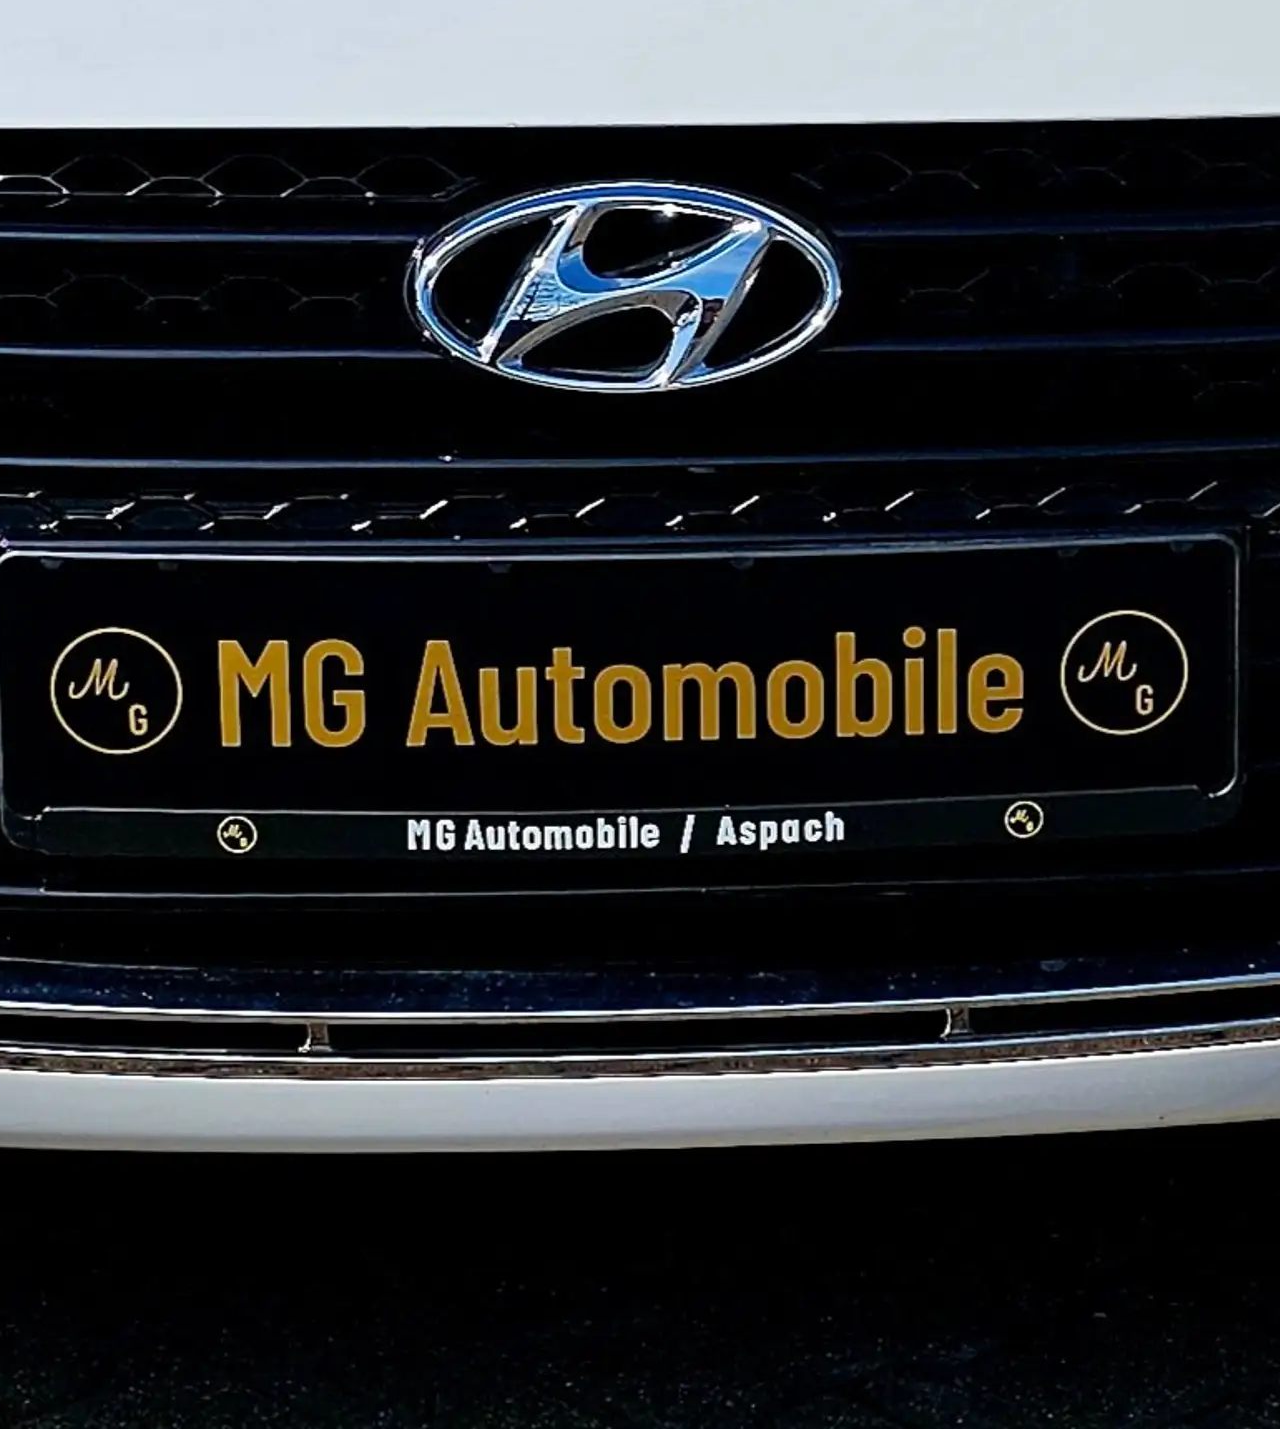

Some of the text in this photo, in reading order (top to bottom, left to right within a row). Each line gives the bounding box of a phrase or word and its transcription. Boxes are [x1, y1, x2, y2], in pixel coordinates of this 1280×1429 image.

[218, 626, 1024, 748] MG Automobile
[407, 819, 456, 851] MG
[464, 816, 661, 851] Automobile
[716, 810, 845, 851] Aspach
